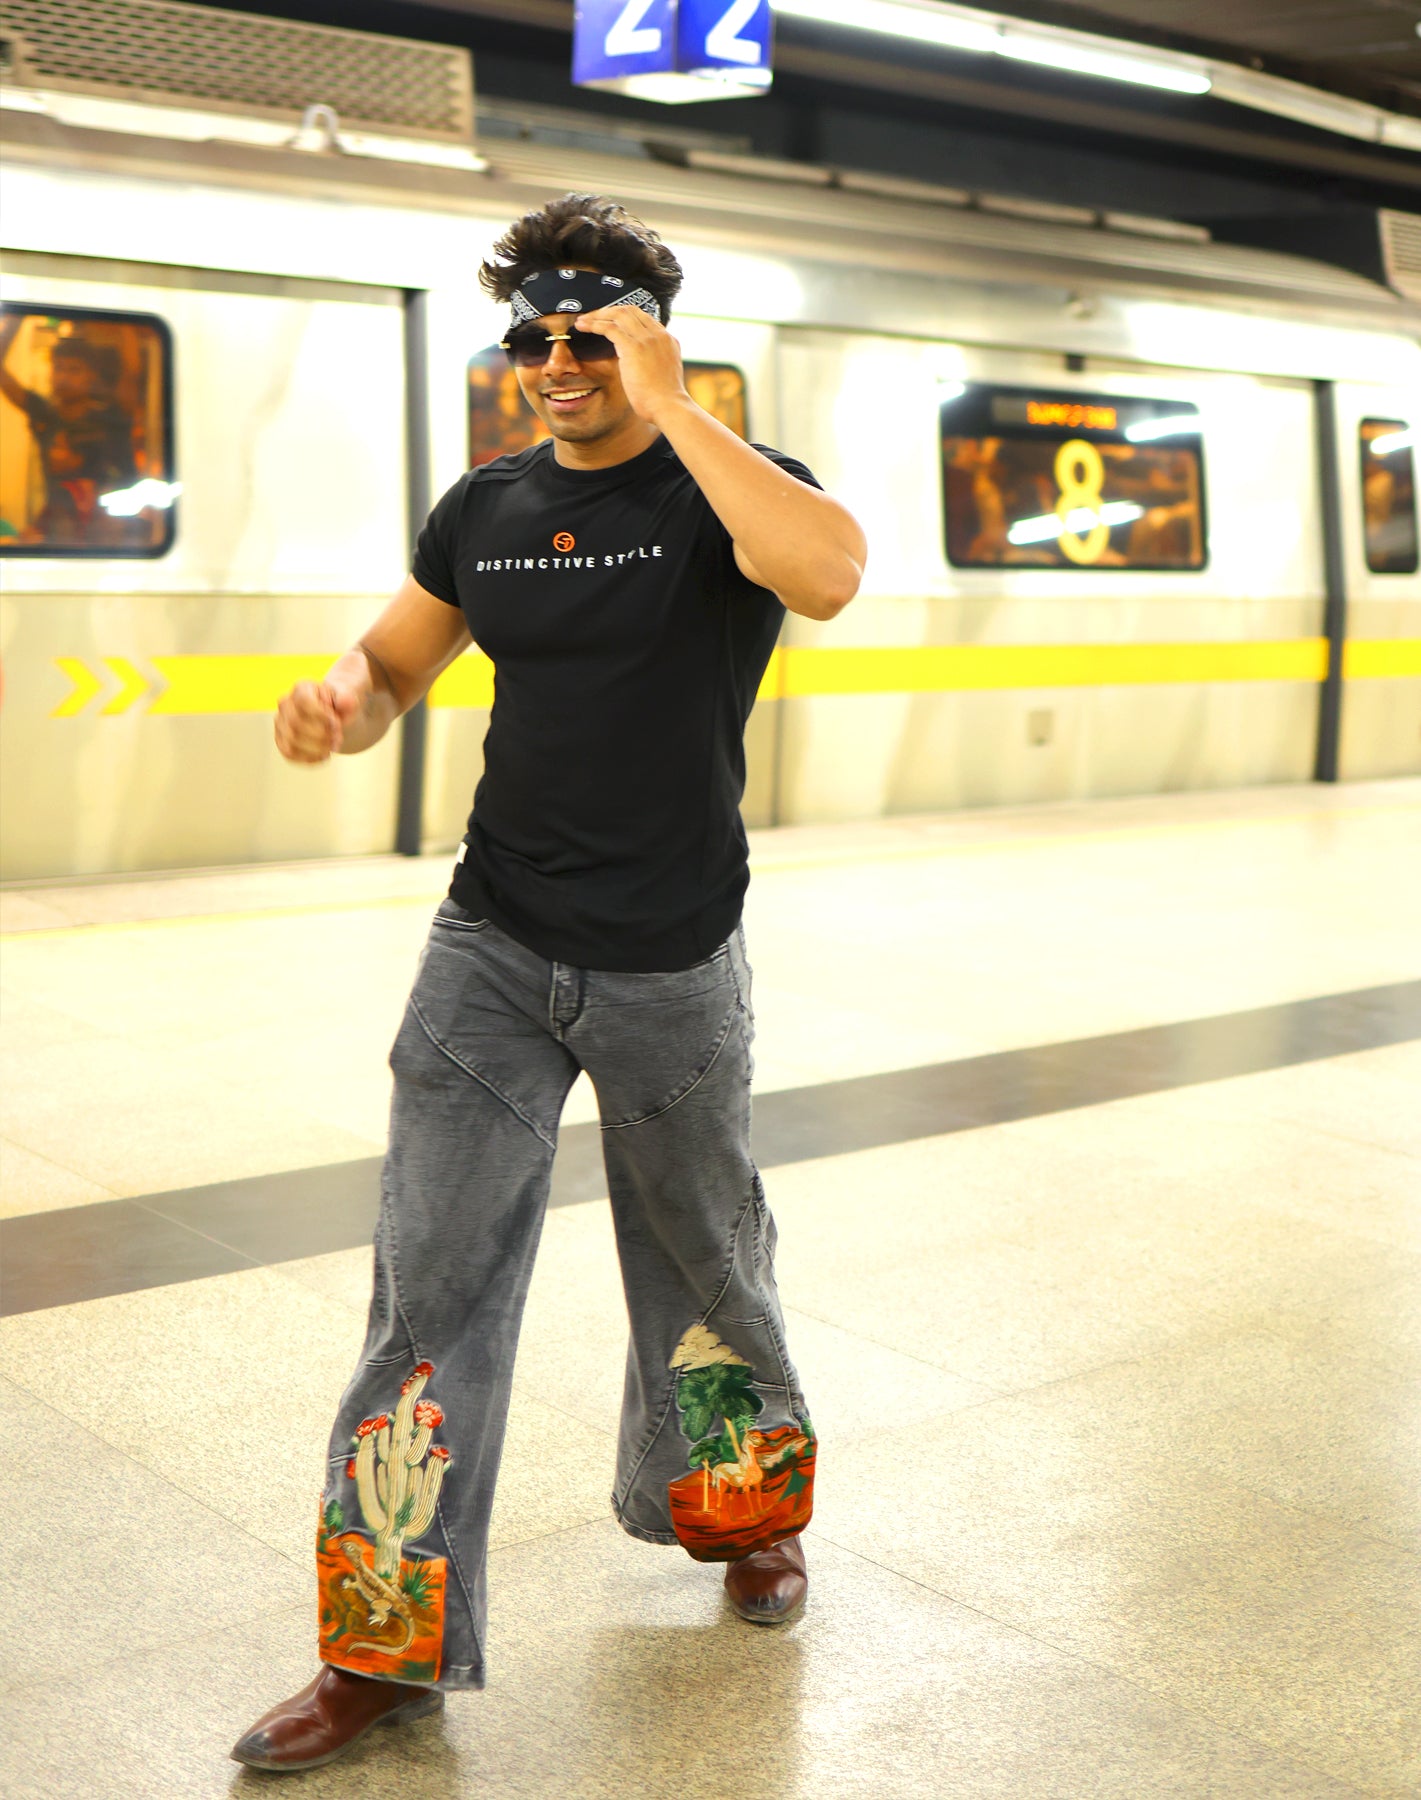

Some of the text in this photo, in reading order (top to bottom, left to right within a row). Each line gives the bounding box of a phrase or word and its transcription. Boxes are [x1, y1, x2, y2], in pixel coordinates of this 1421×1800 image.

[705, 0, 762, 65] 2
[1054, 439, 1110, 565] 8
[476, 556, 595, 572] DISTINCTIVE
